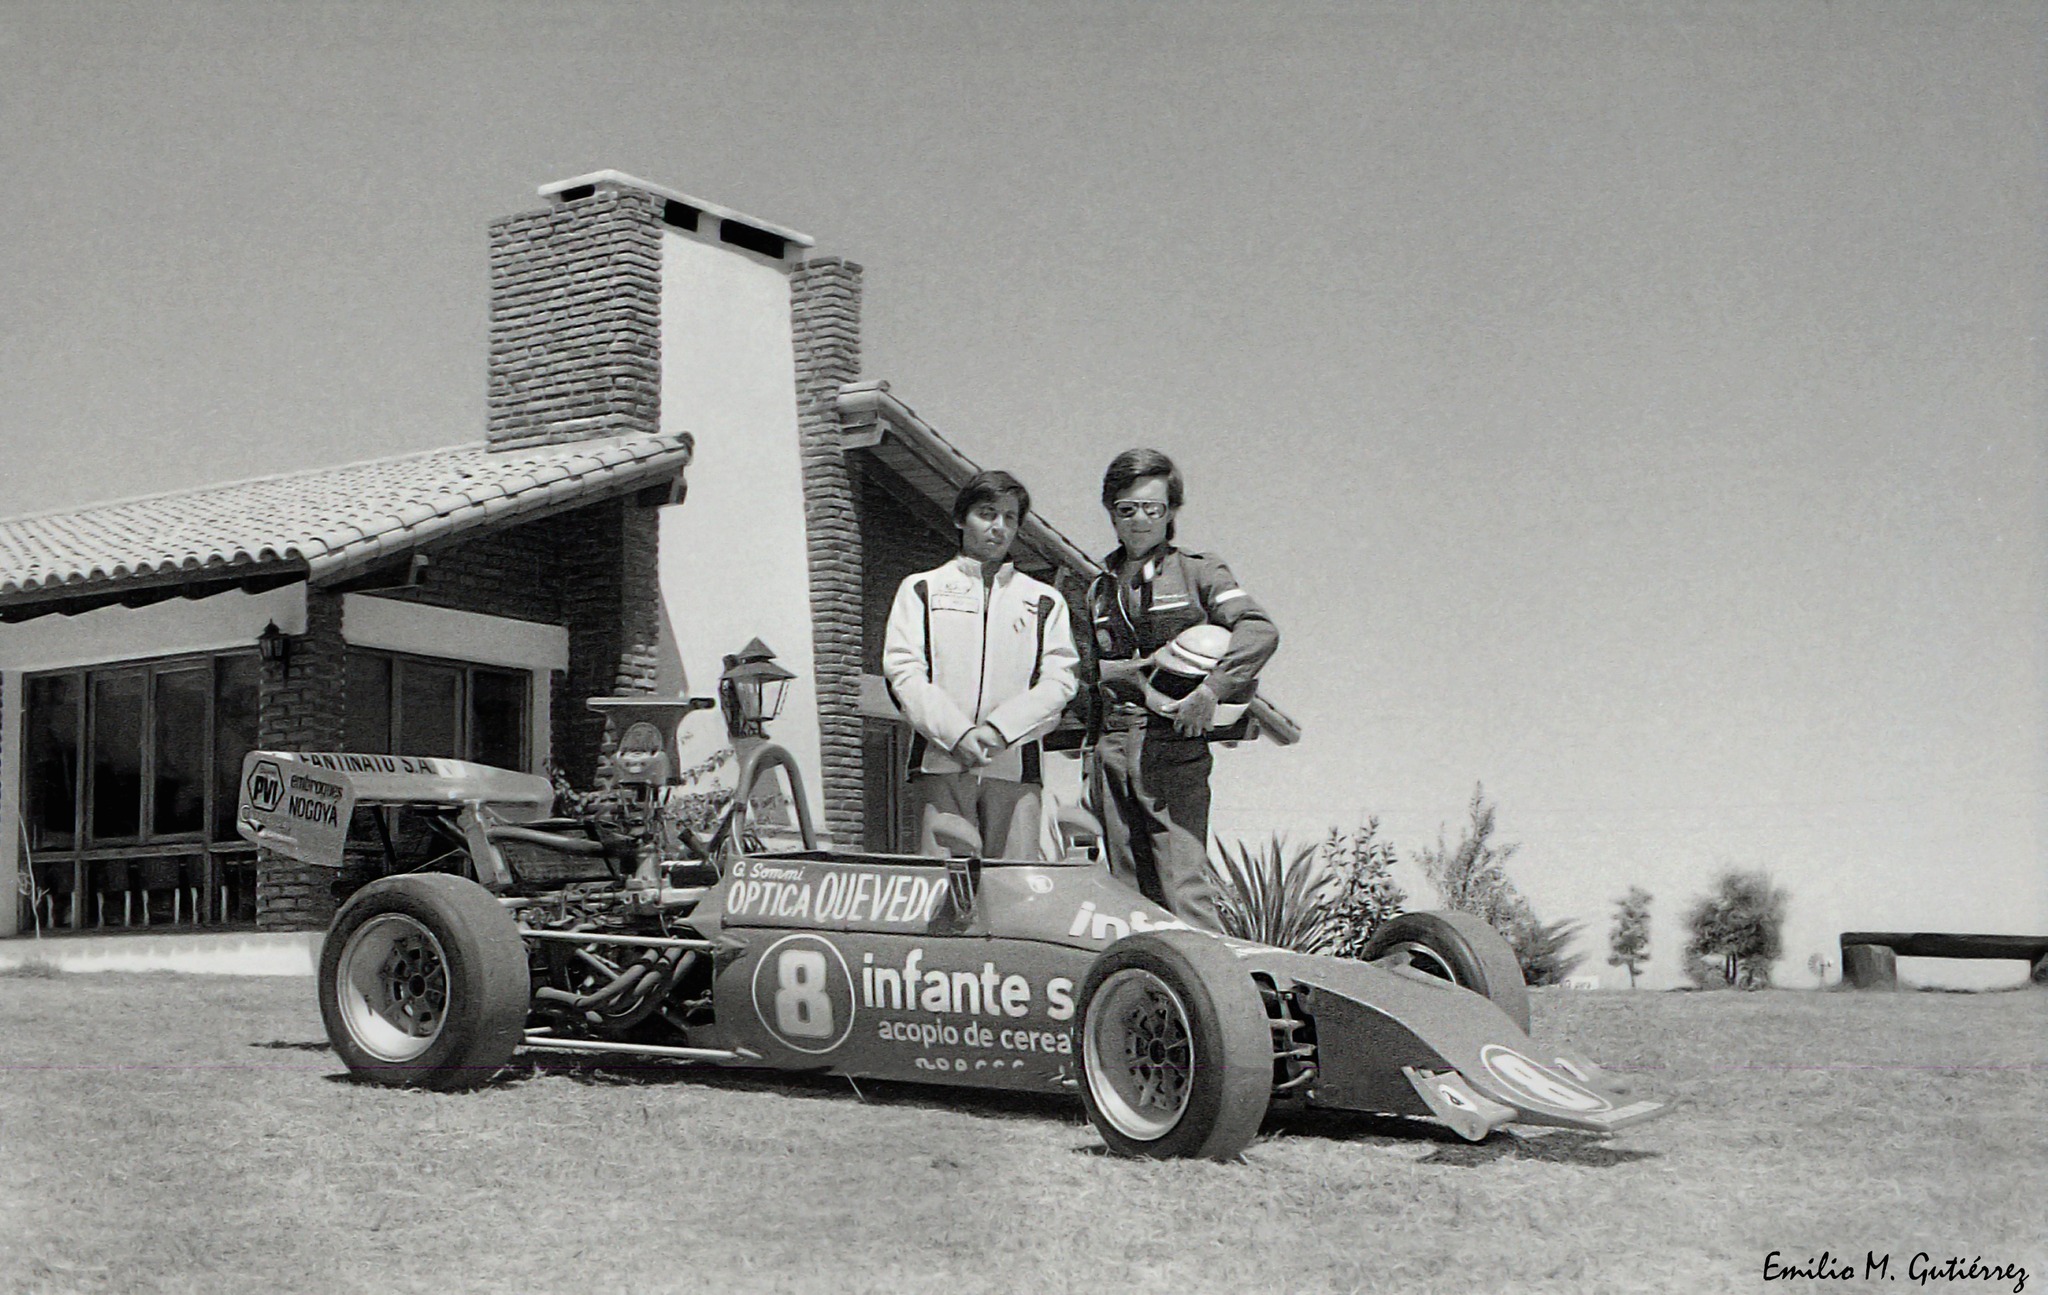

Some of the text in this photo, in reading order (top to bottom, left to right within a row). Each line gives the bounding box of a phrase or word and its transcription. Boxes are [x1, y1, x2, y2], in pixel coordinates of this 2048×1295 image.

[253, 775, 278, 805] PVI
[288, 795, 338, 828] NOGOYÁ
[750, 862, 806, 881] Sommi
[727, 879, 811, 918] OPTICA
[774, 949, 835, 1037] 8
[861, 948, 1031, 1019] infante
[878, 1017, 1074, 1055] acopio de cerea
